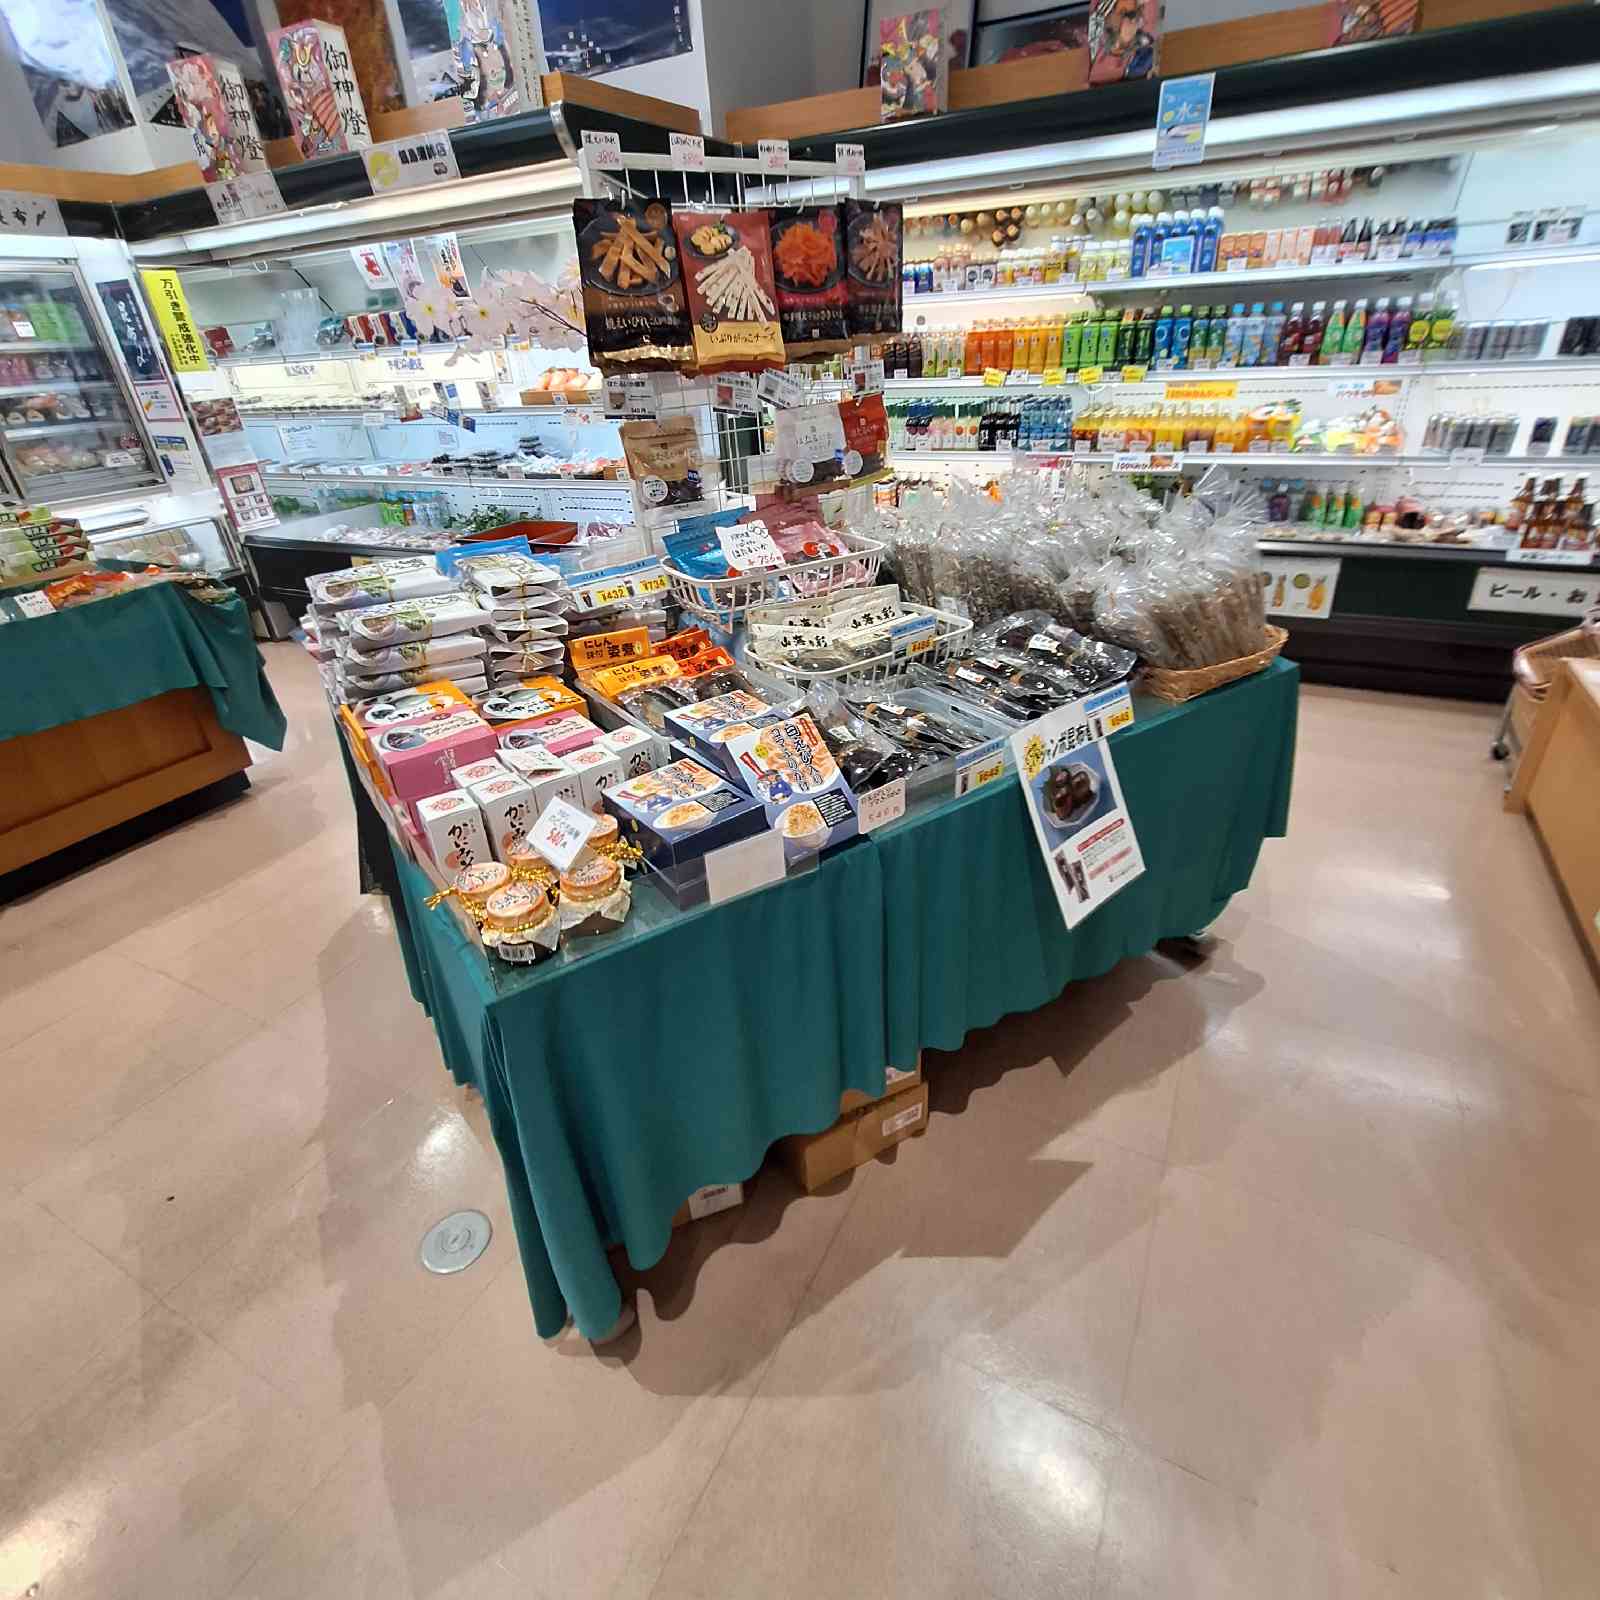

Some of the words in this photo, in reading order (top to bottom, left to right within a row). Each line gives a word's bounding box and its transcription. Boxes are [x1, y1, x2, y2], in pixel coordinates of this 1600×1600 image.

[323, 40, 367, 136] 御神燈
[221, 74, 265, 161] 御神燈
[583, 638, 612, 649] にしん
[606, 642, 636, 659] 姿煮
[612, 663, 641, 677] にしん
[639, 665, 665, 681] 姿煮
